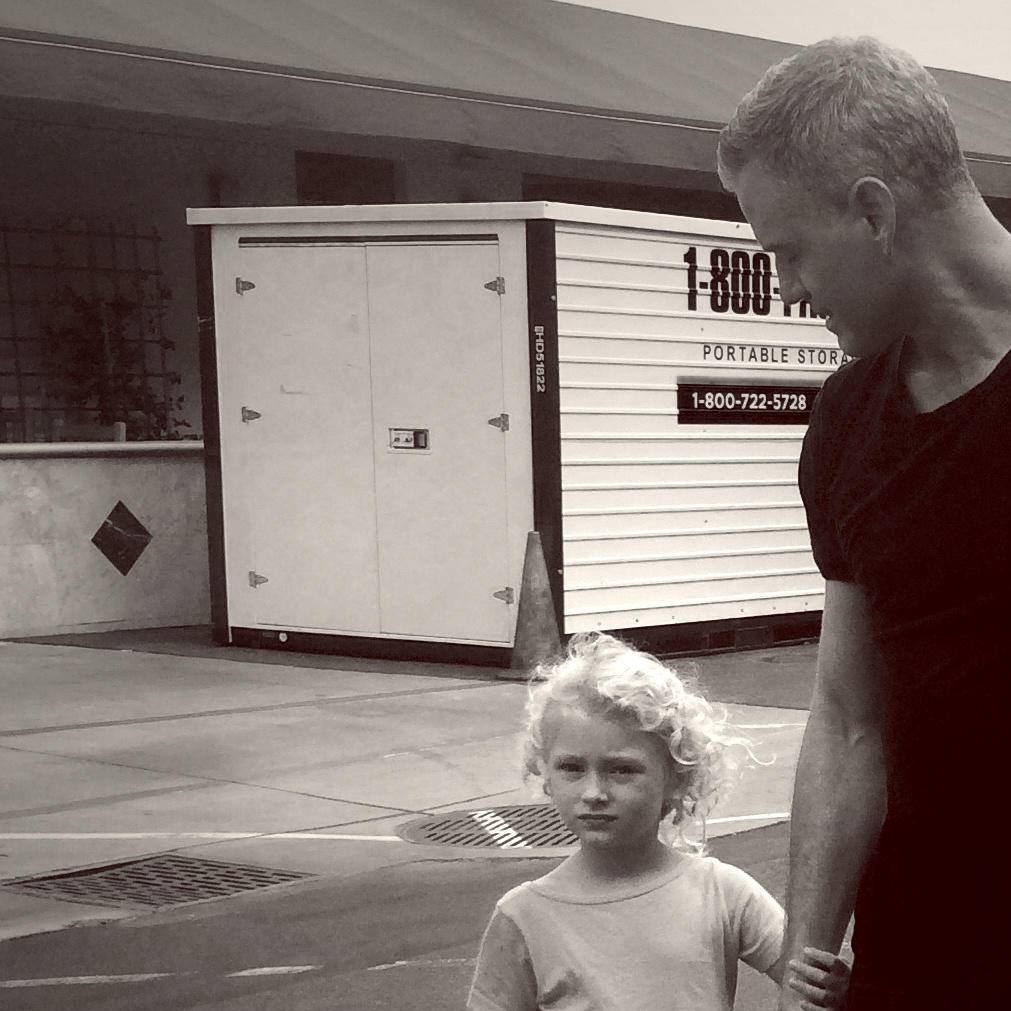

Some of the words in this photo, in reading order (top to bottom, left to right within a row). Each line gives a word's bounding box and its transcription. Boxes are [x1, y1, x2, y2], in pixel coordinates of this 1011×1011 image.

[683, 246, 829, 319] 1-800-
[703, 344, 789, 364] PORTABLE
[797, 348, 849, 366] STORA
[691, 391, 808, 411] 1-800-722-5728
